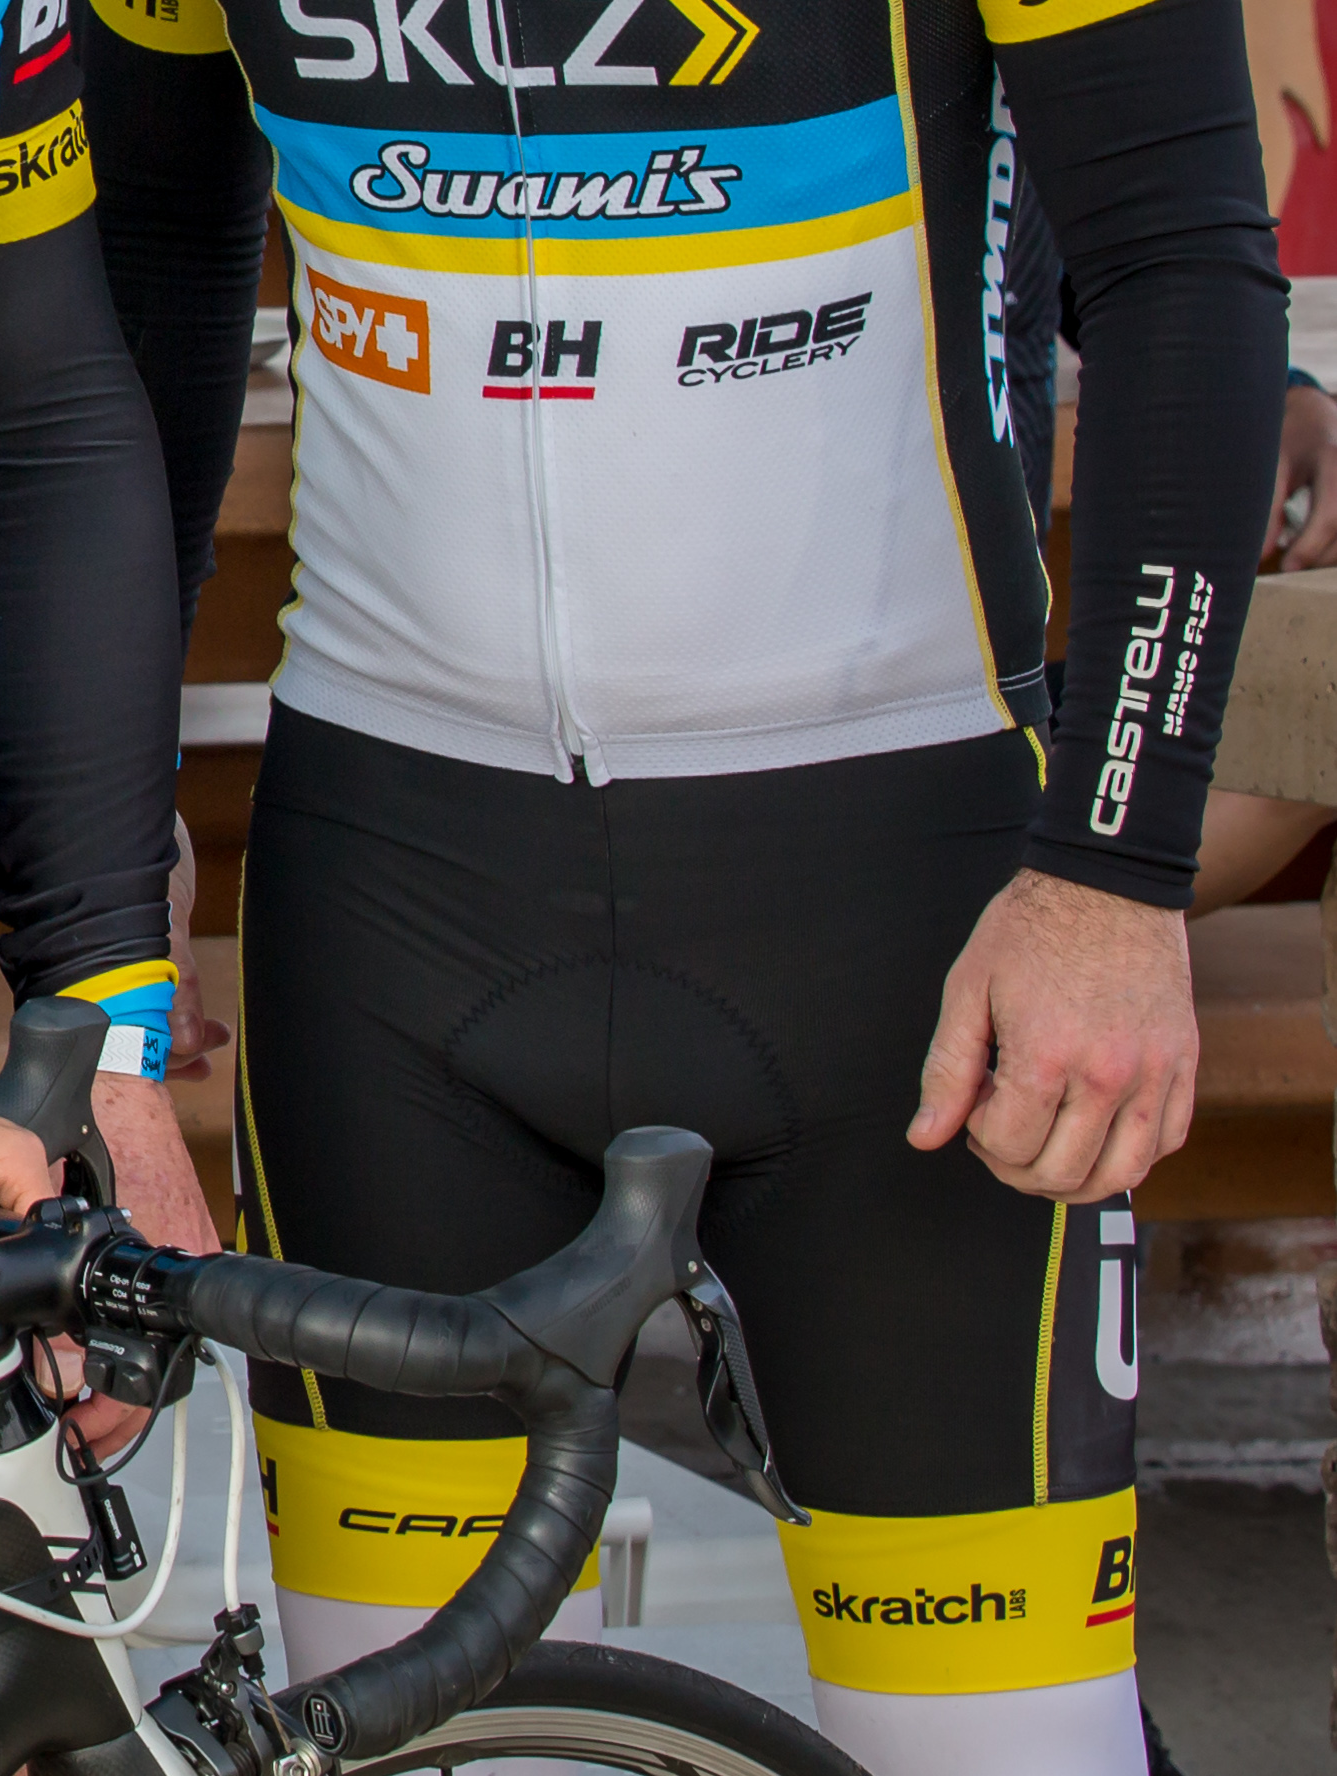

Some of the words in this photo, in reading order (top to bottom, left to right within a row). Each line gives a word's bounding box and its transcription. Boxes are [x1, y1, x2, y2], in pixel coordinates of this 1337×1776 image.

[349, 141, 743, 219] Swami's
[485, 319, 603, 378] BH
[677, 291, 873, 366] RIDE
[677, 335, 862, 388] CYCLERY
[1162, 650, 1198, 737] NANO
[1182, 571, 1214, 645] FLEX
[1090, 563, 1175, 837] CASTELLI
[812, 1582, 1007, 1625] skratch
[1009, 1588, 1027, 1620] LABS
